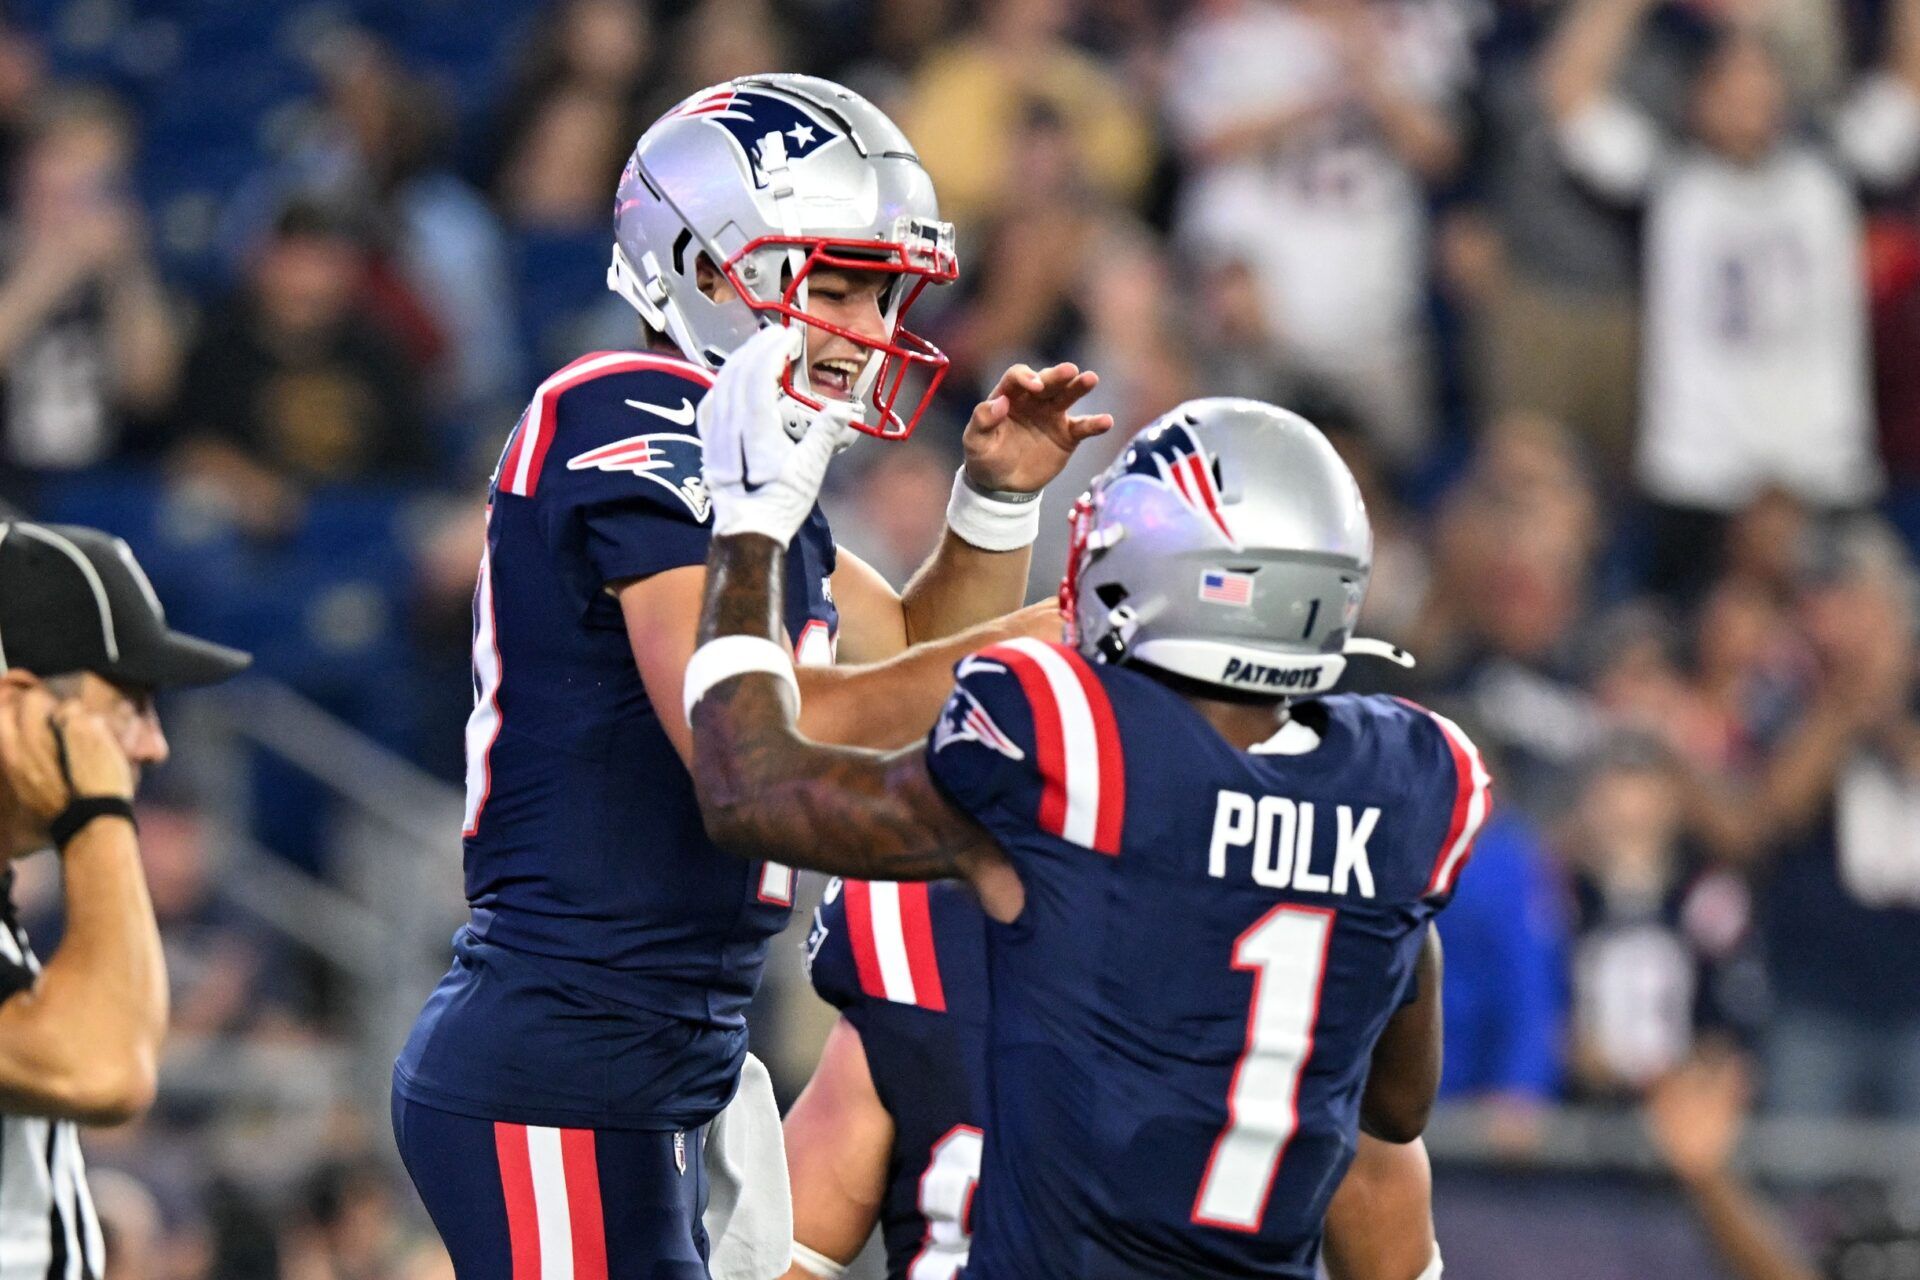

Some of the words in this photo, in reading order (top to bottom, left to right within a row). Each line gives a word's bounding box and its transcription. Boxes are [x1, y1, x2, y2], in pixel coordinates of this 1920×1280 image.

[1302, 597, 1321, 640] 1
[1222, 656, 1323, 688] PATRIOTS
[1207, 788, 1382, 899] POLK
[1189, 902, 1338, 1234] 1
